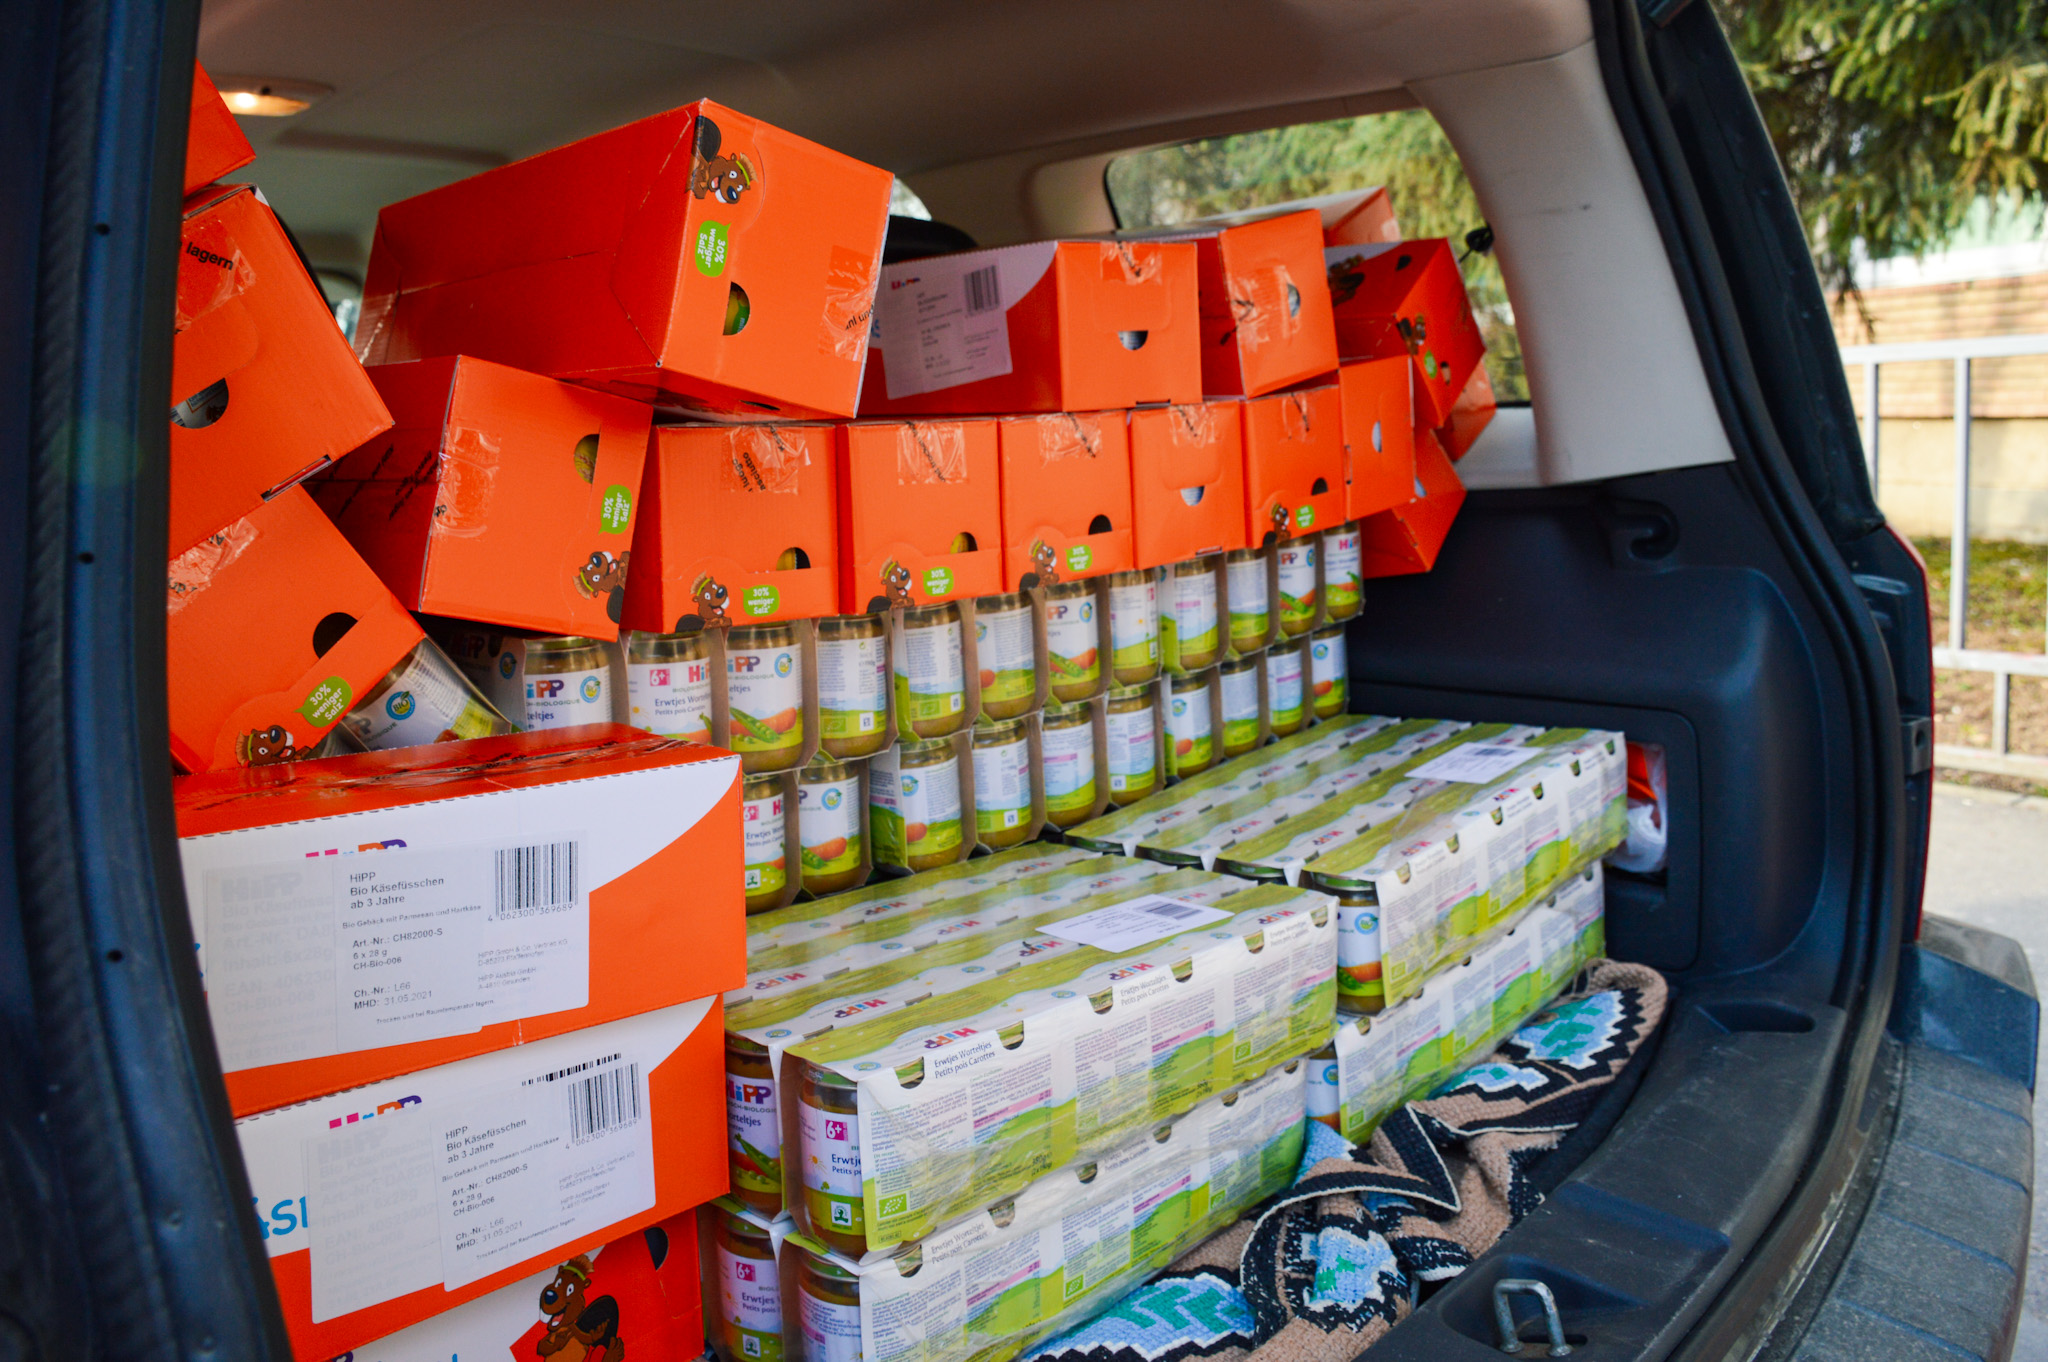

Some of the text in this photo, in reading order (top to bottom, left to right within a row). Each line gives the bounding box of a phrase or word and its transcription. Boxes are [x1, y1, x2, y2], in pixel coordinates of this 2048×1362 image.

[186, 241, 234, 271] lagern
[705, 228, 716, 268] weniger
[714, 239, 726, 263] 30%
[742, 452, 766, 491] asciutto
[603, 497, 614, 519] 30%
[612, 492, 623, 528] weniger
[753, 587, 770, 597] 30%
[748, 597, 775, 607] weniger
[727, 656, 761, 673] iPP
[310, 684, 332, 706] 30%
[526, 680, 565, 698] iPP
[729, 684, 751, 694] eltjes
[312, 687, 342, 718] weniger
[655, 697, 686, 707] Erwtjes
[527, 711, 555, 721] teltjes
[350, 871, 376, 883] HiPP
[350, 878, 444, 897] Bio Käsefüsschen
[350, 895, 405, 909] ab 3 Jahre
[488, 903, 573, 922] 4 062300 369689
[352, 927, 443, 948] Art.-Nr.: CH82000-S
[353, 952, 359, 960] 6
[369, 949, 379, 958] 28
[382, 949, 388, 957] g
[353, 957, 402, 970] CH-Bio-006
[354, 981, 411, 998] Ch.-Nr.: L66
[354, 990, 432, 1010] MHD: 31.05.2021
[924, 1027, 979, 1049] HiPP
[934, 1041, 992, 1068] Erwtjes Worteltjes
[934, 1051, 996, 1079] Petits pois Carottes
[729, 1112, 761, 1127] orteltjes
[445, 1125, 468, 1140] HiPP
[446, 1119, 527, 1152] Bio Käsefüsschen
[826, 1120, 842, 1139] 6+
[447, 1142, 494, 1164] ab 3 Jahre
[832, 1165, 852, 1175] Petits
[453, 1196, 495, 1216] CH-Bio-006
[456, 1238, 479, 1251] MHD:
[742, 1292, 775, 1306] Erwtjes
[743, 1302, 776, 1315] Petits pois
